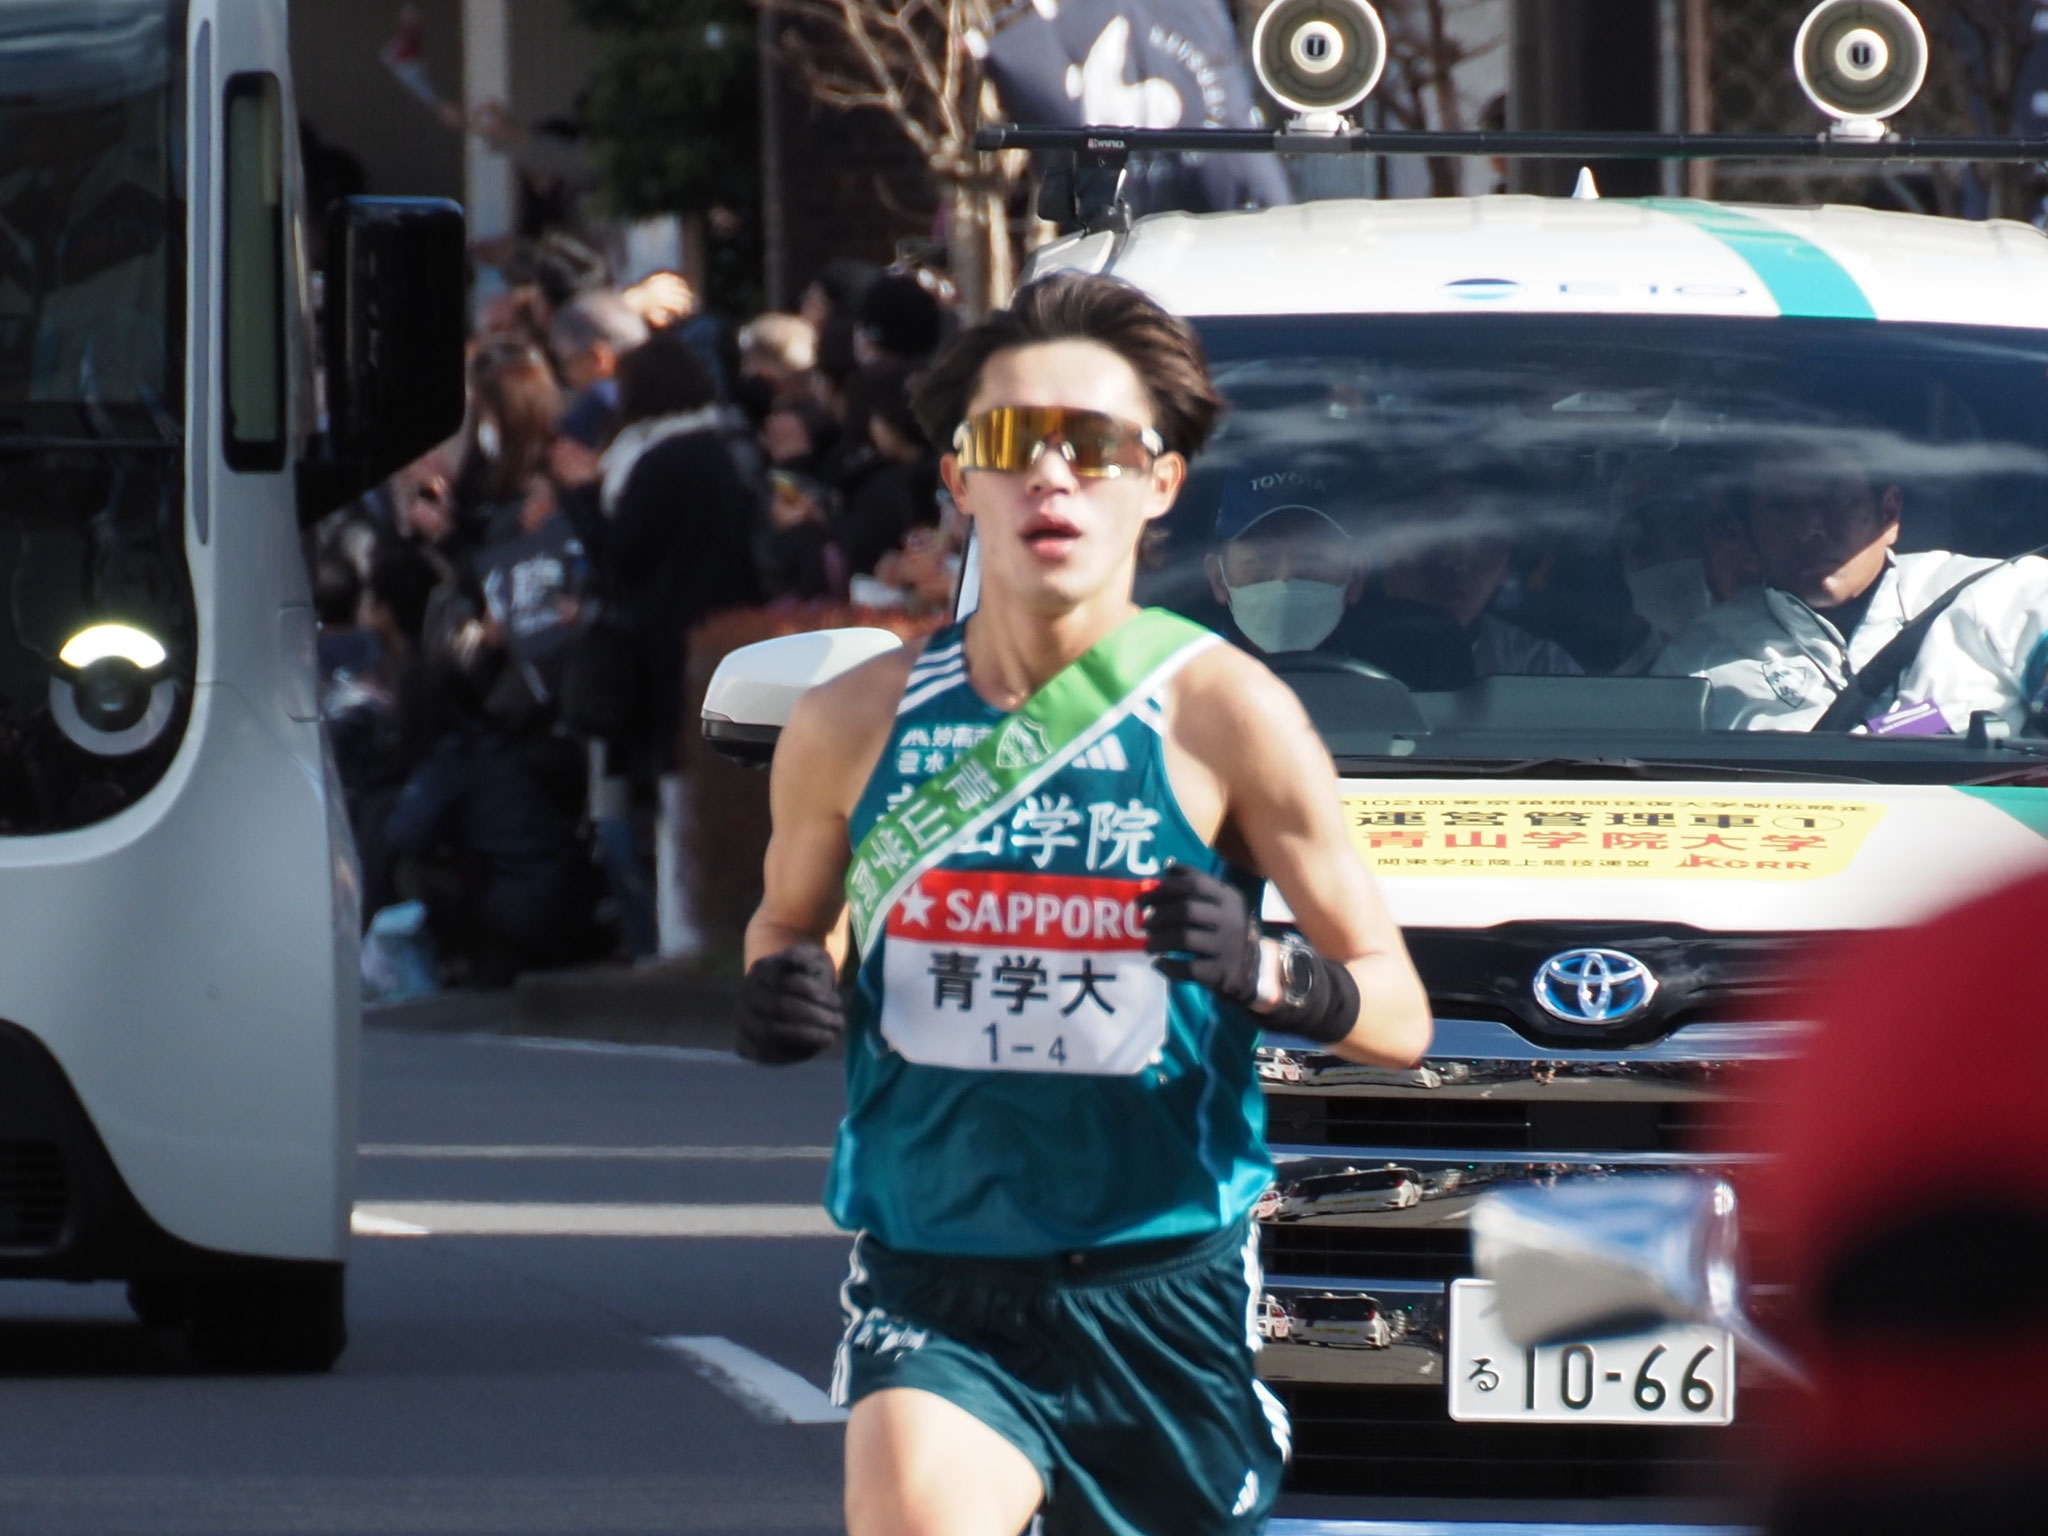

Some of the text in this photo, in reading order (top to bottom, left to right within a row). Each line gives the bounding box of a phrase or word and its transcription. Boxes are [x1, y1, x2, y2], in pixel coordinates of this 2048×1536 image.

[1363, 830, 1829, 852] 青山学院大学
[927, 951, 1117, 1018] 青学大
[1468, 1343, 1715, 1412] る 10-66
